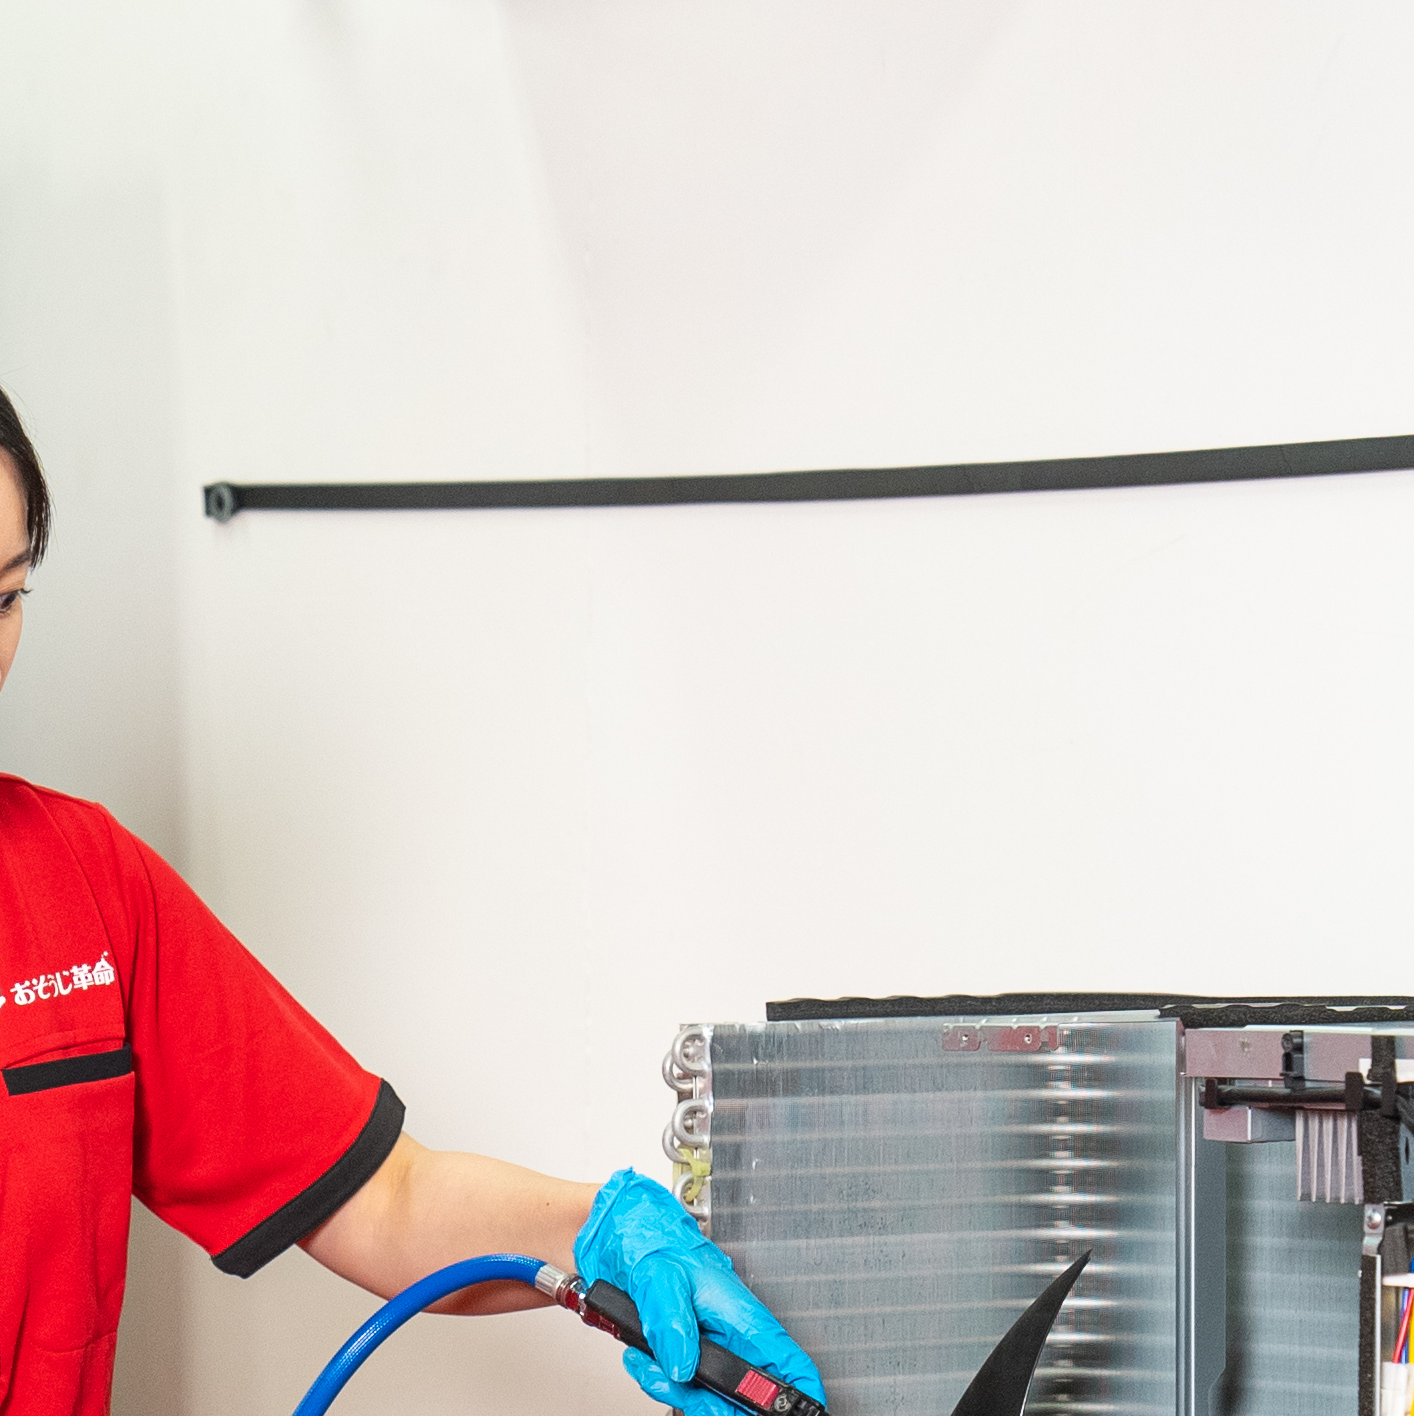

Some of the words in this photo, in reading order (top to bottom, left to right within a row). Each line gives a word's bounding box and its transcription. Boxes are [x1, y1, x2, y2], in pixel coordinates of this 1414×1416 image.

[9, 951, 116, 1006] おそうじ革命
